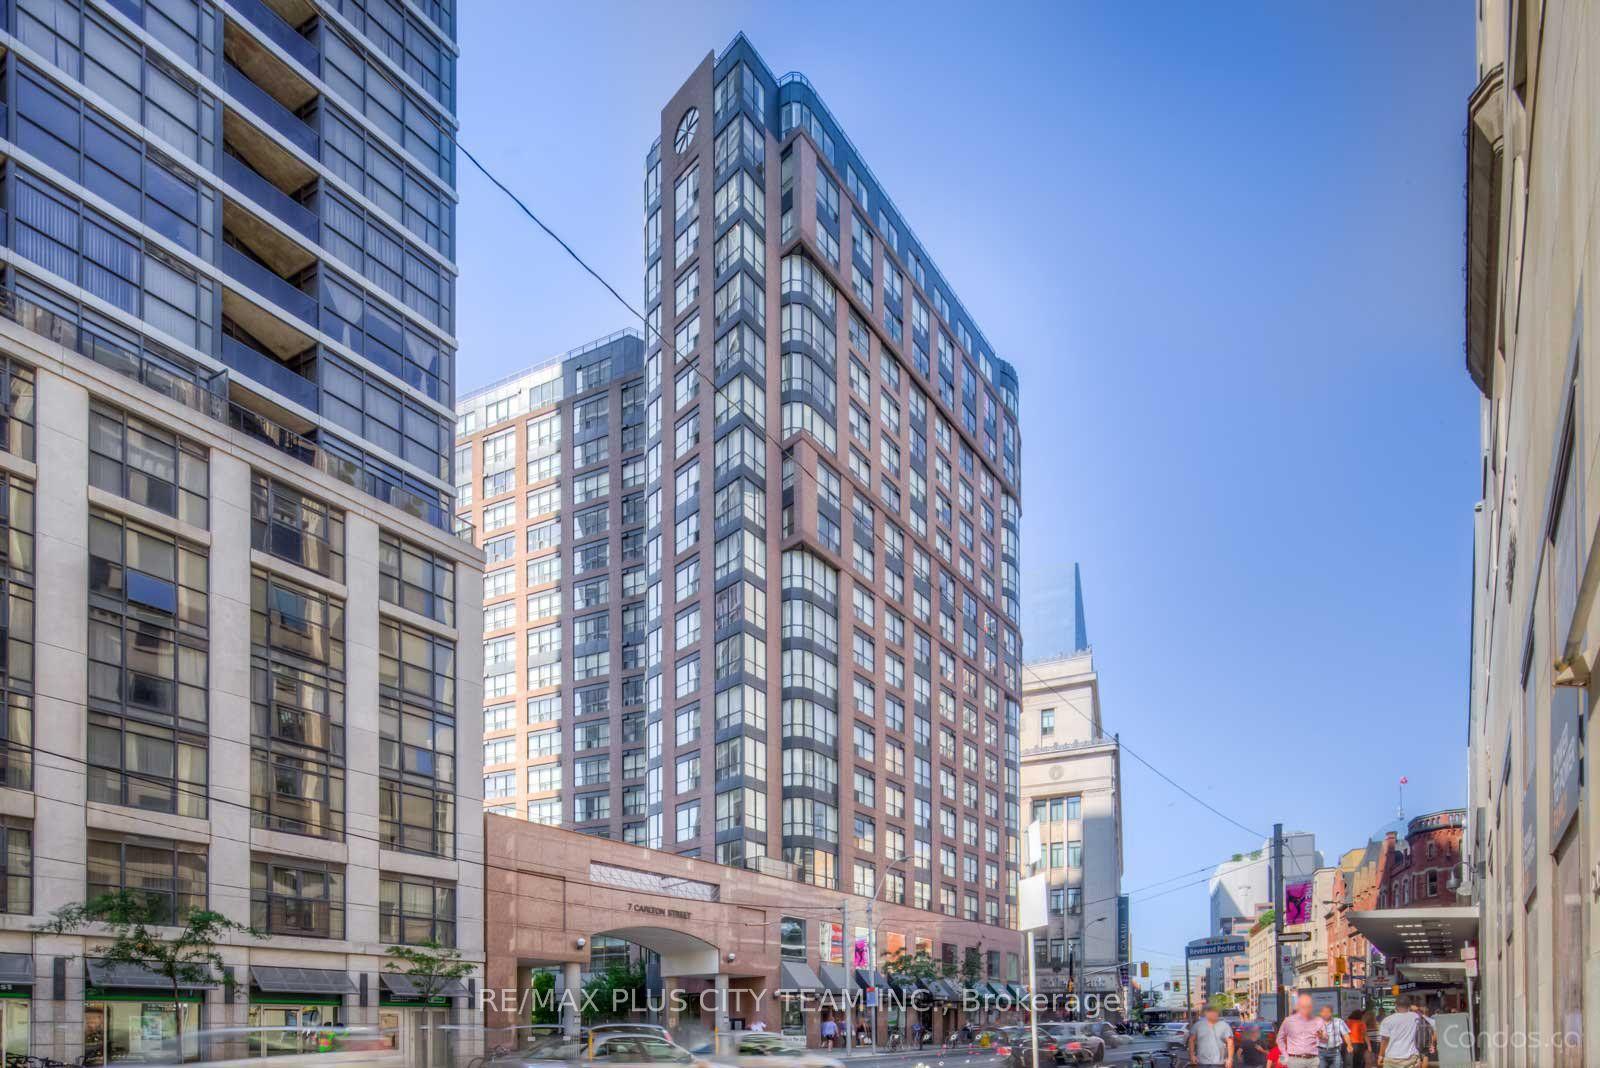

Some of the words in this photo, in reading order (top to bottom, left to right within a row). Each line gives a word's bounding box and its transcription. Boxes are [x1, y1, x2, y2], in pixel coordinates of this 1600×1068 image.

[627, 903, 632, 911] 7
[634, 904, 666, 915] CARLTON
[1189, 946, 1216, 955] Reverend
[1217, 944, 1236, 953] Porter
